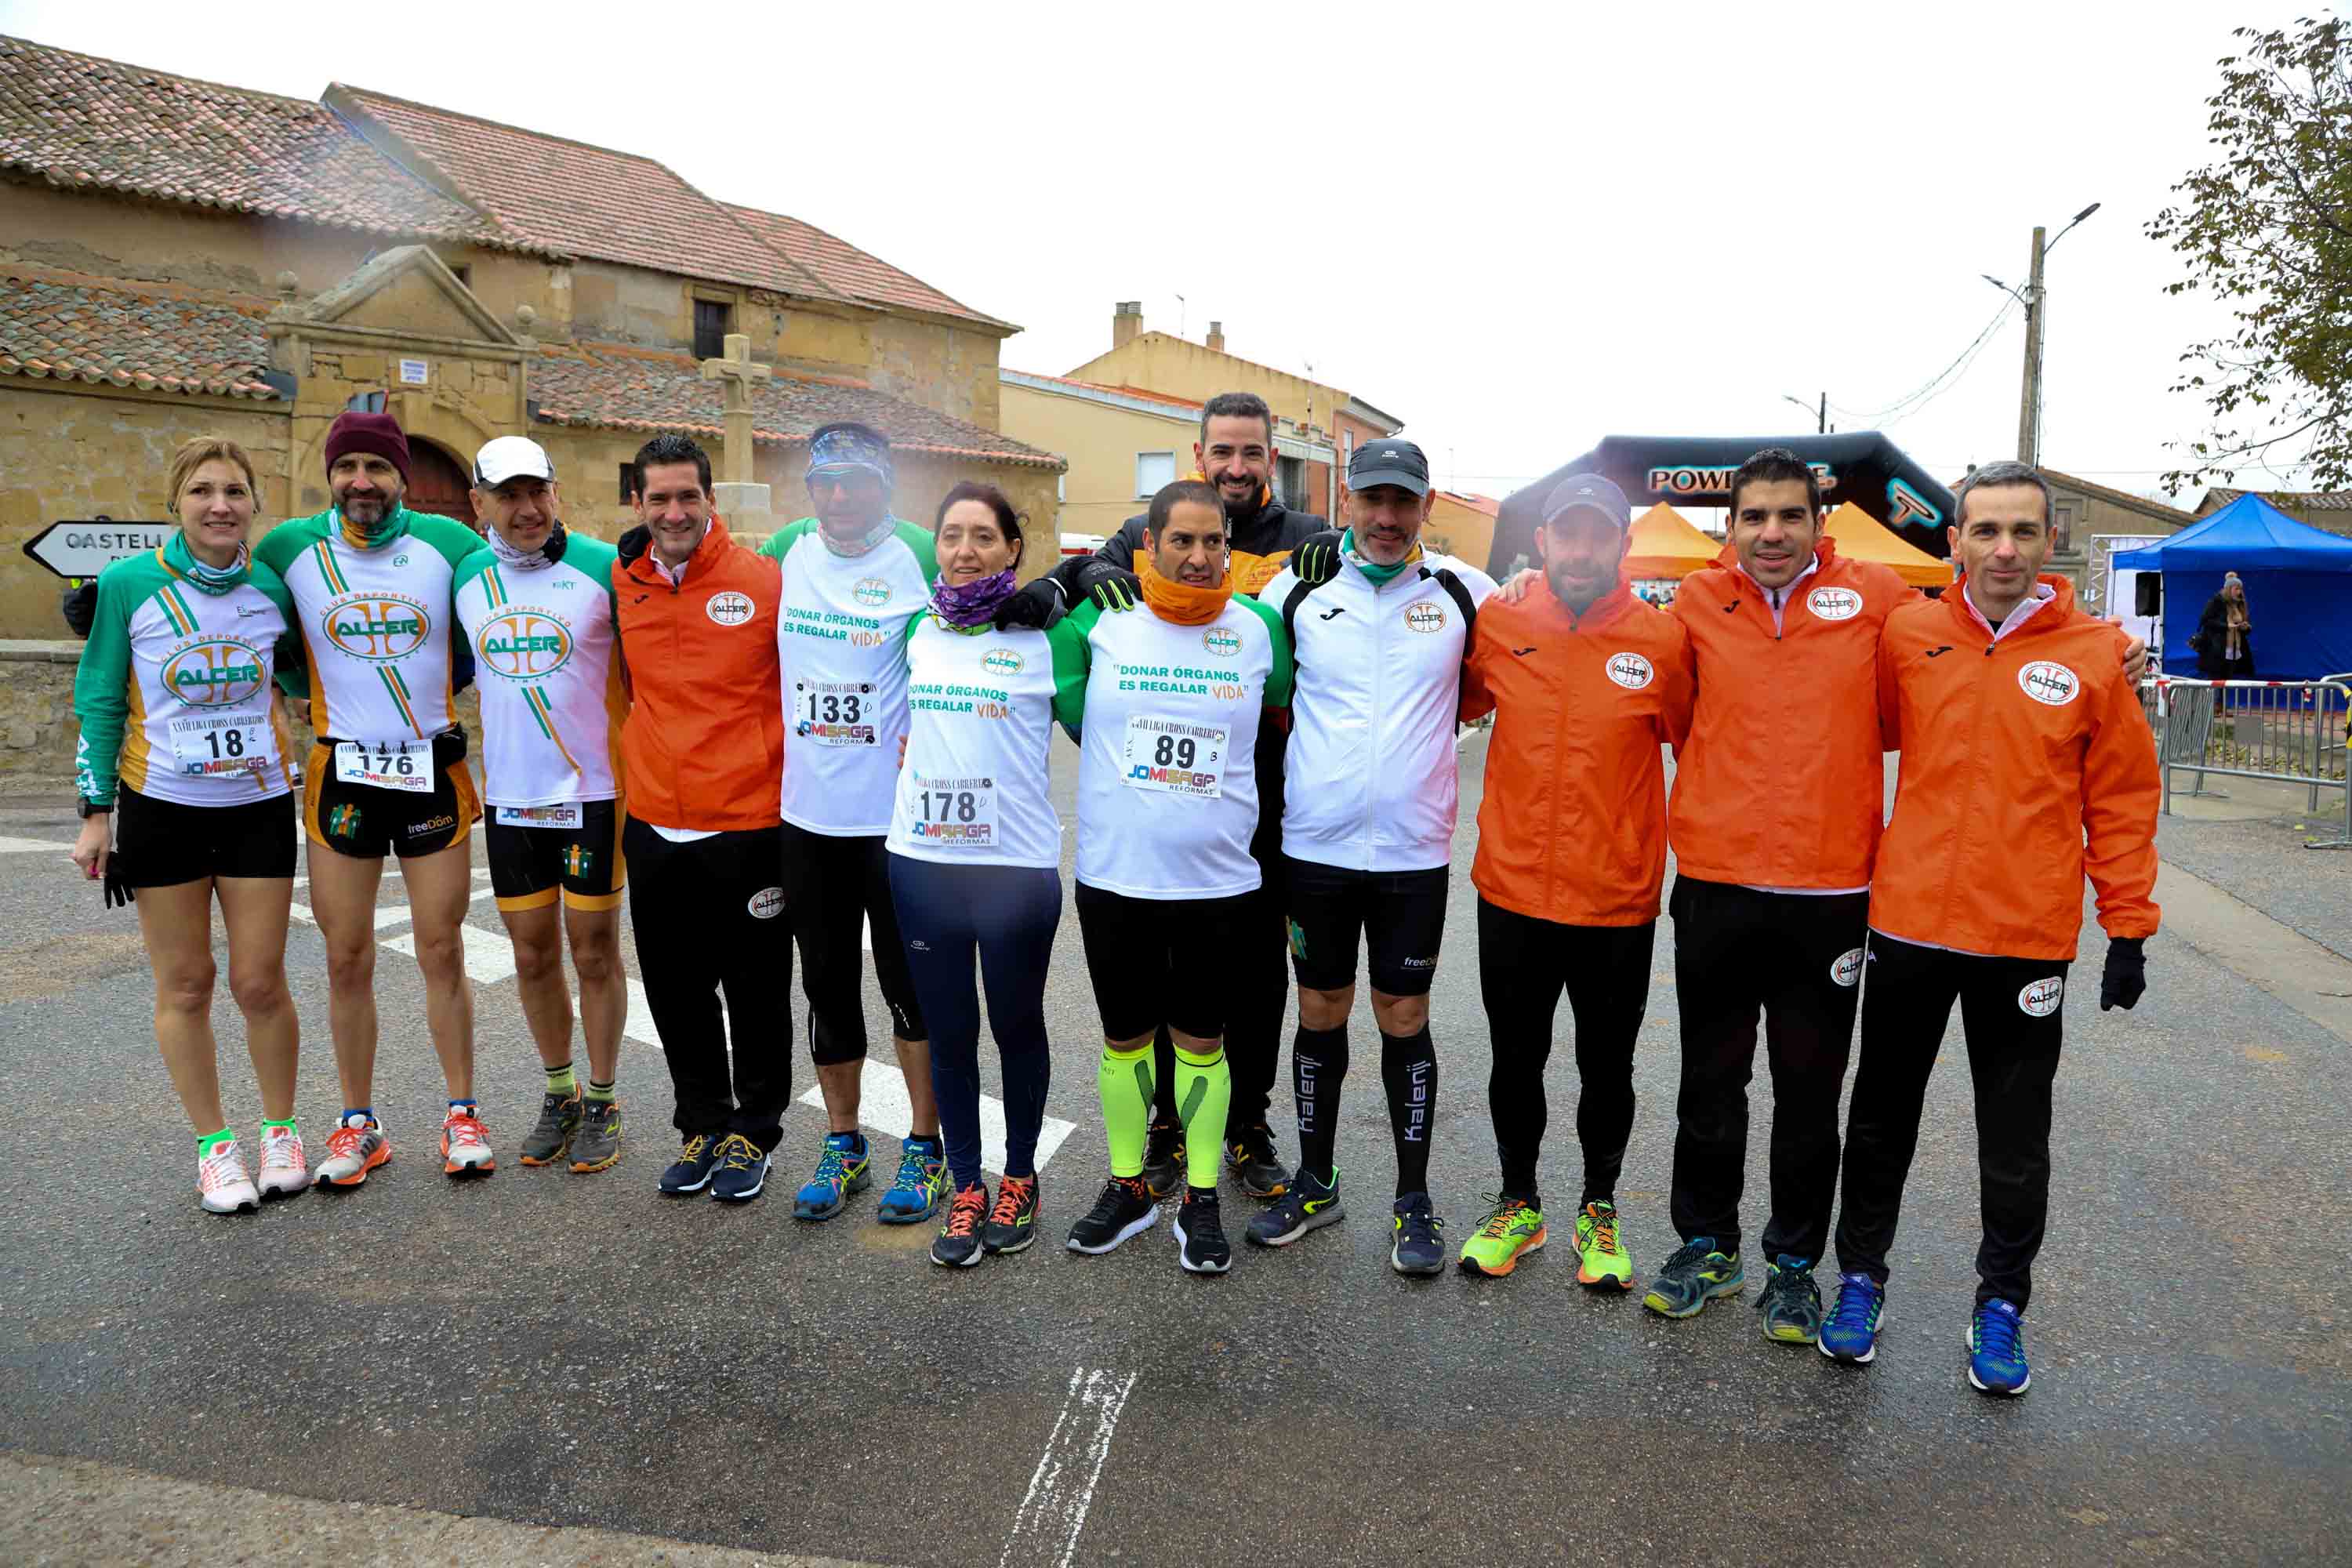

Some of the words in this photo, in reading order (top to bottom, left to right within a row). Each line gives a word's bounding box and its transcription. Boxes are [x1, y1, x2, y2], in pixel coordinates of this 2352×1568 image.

[1652, 470, 1732, 491] POW
[715, 604, 747, 615] ALCER
[1410, 614, 1442, 622] ALCER
[336, 619, 420, 636] ALCER
[797, 624, 848, 641] REGALAR
[485, 636, 563, 655] ALCER
[175, 665, 262, 686] ALCER
[1615, 665, 1645, 680] ALCER
[1119, 680, 1136, 691] ES
[1140, 681, 1207, 695] REGALAR
[2029, 674, 2070, 695] ALCER
[808, 693, 860, 724] 133
[918, 699, 972, 713] REGALAR
[797, 719, 873, 739] JOMISAGA
[1166, 722, 1186, 735] CROSS
[205, 729, 244, 759] 18
[1155, 735, 1196, 768] 89
[182, 756, 267, 775] JOMISAGA
[358, 754, 413, 775] 176
[345, 768, 427, 786] JOMISAGA
[1127, 765, 1216, 787] JOMISAGA
[1169, 784, 1213, 795] REFORMAS
[920, 791, 976, 822] 178
[912, 822, 992, 838] JOMISAGA
